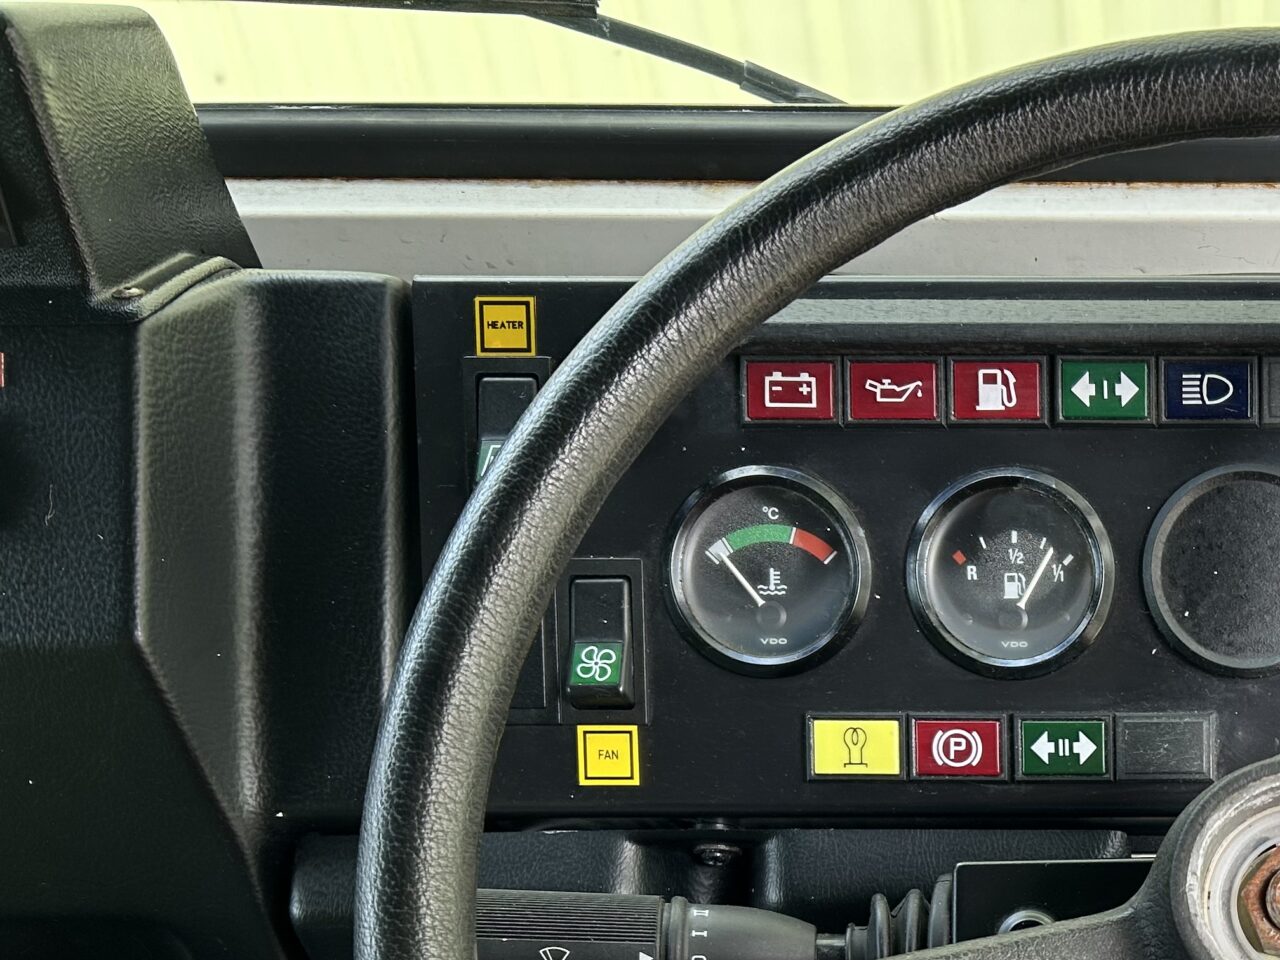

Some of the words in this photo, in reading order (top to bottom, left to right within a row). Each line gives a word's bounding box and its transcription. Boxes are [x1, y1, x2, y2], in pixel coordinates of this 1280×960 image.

[486, 320, 524, 330] HEATER
[966, 565, 978, 581] R
[760, 637, 788, 645] VDO
[1001, 640, 1029, 648] VDO
[598, 750, 619, 760] FAN
